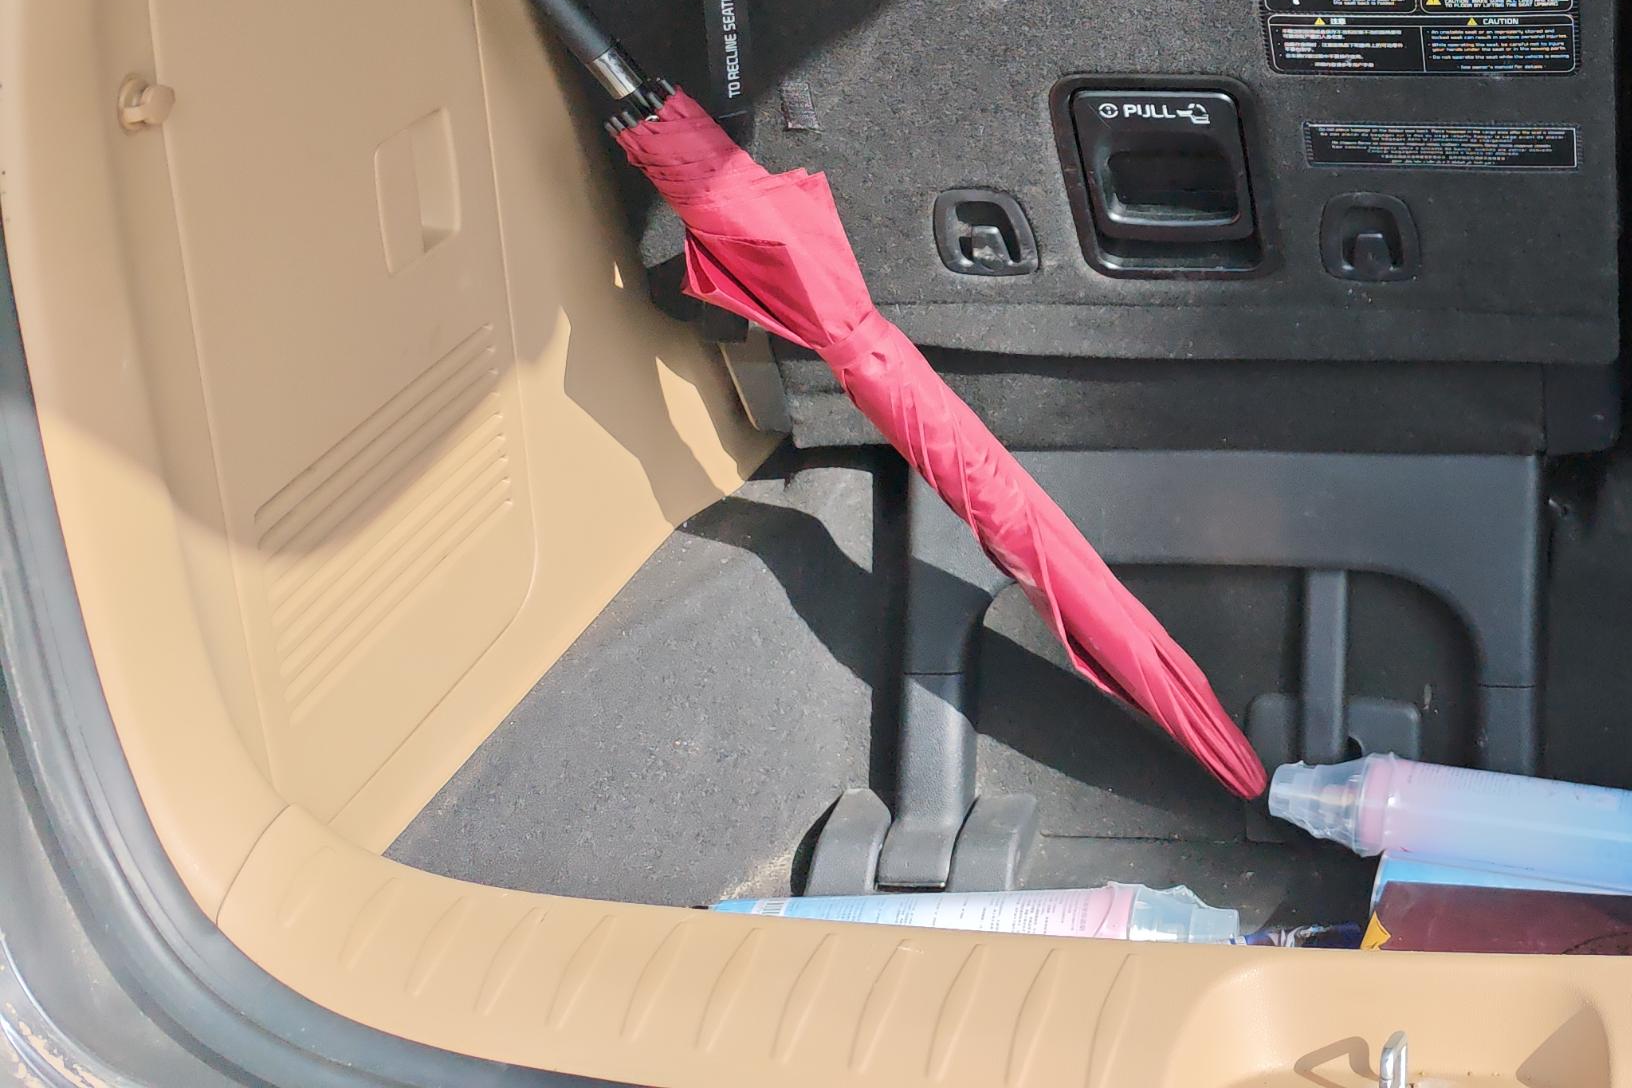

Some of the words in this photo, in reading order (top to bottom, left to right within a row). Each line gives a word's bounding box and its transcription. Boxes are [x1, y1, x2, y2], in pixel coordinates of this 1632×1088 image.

[724, 33, 740, 82] RECLINE
[728, 82, 741, 99] TO
[1122, 103, 1176, 119] PULL
